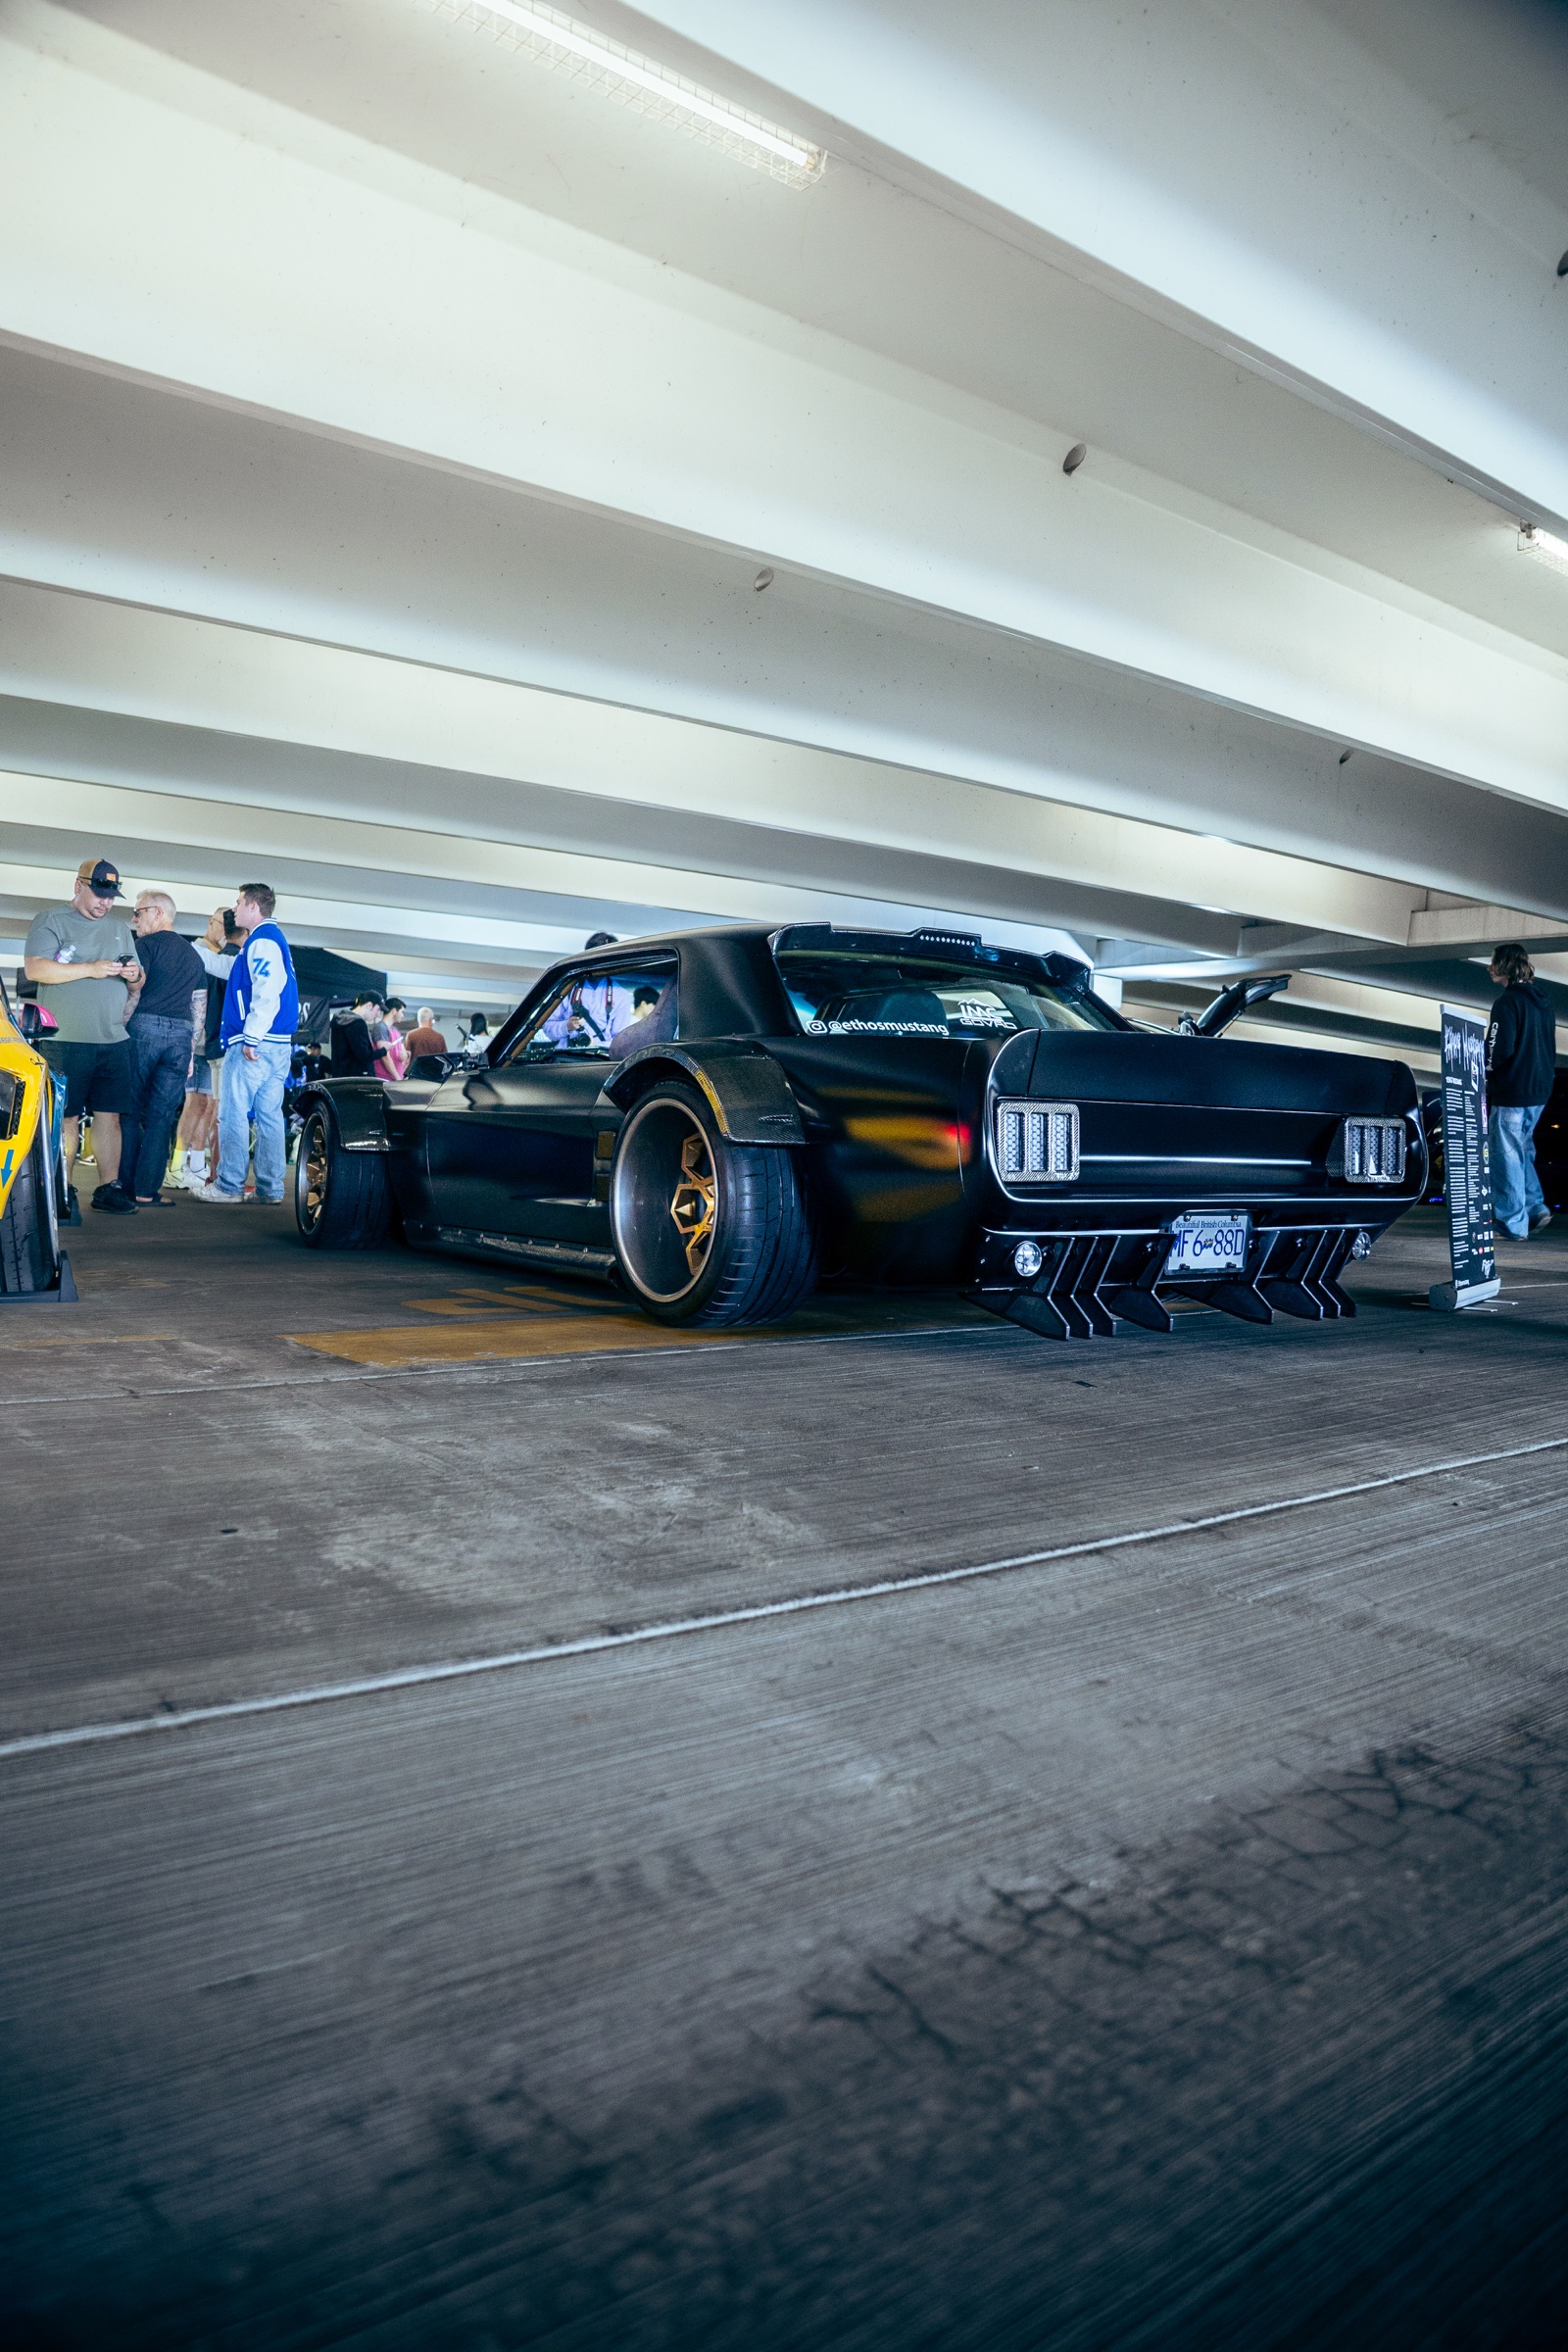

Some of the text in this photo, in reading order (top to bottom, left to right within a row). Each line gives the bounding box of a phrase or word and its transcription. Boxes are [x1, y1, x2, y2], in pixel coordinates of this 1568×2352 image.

[252, 957, 270, 977] 74
[828, 1018, 950, 1036] @ethosmustang
[1200, 1220, 1217, 1229] British
[1213, 1229, 1246, 1256] 88D
